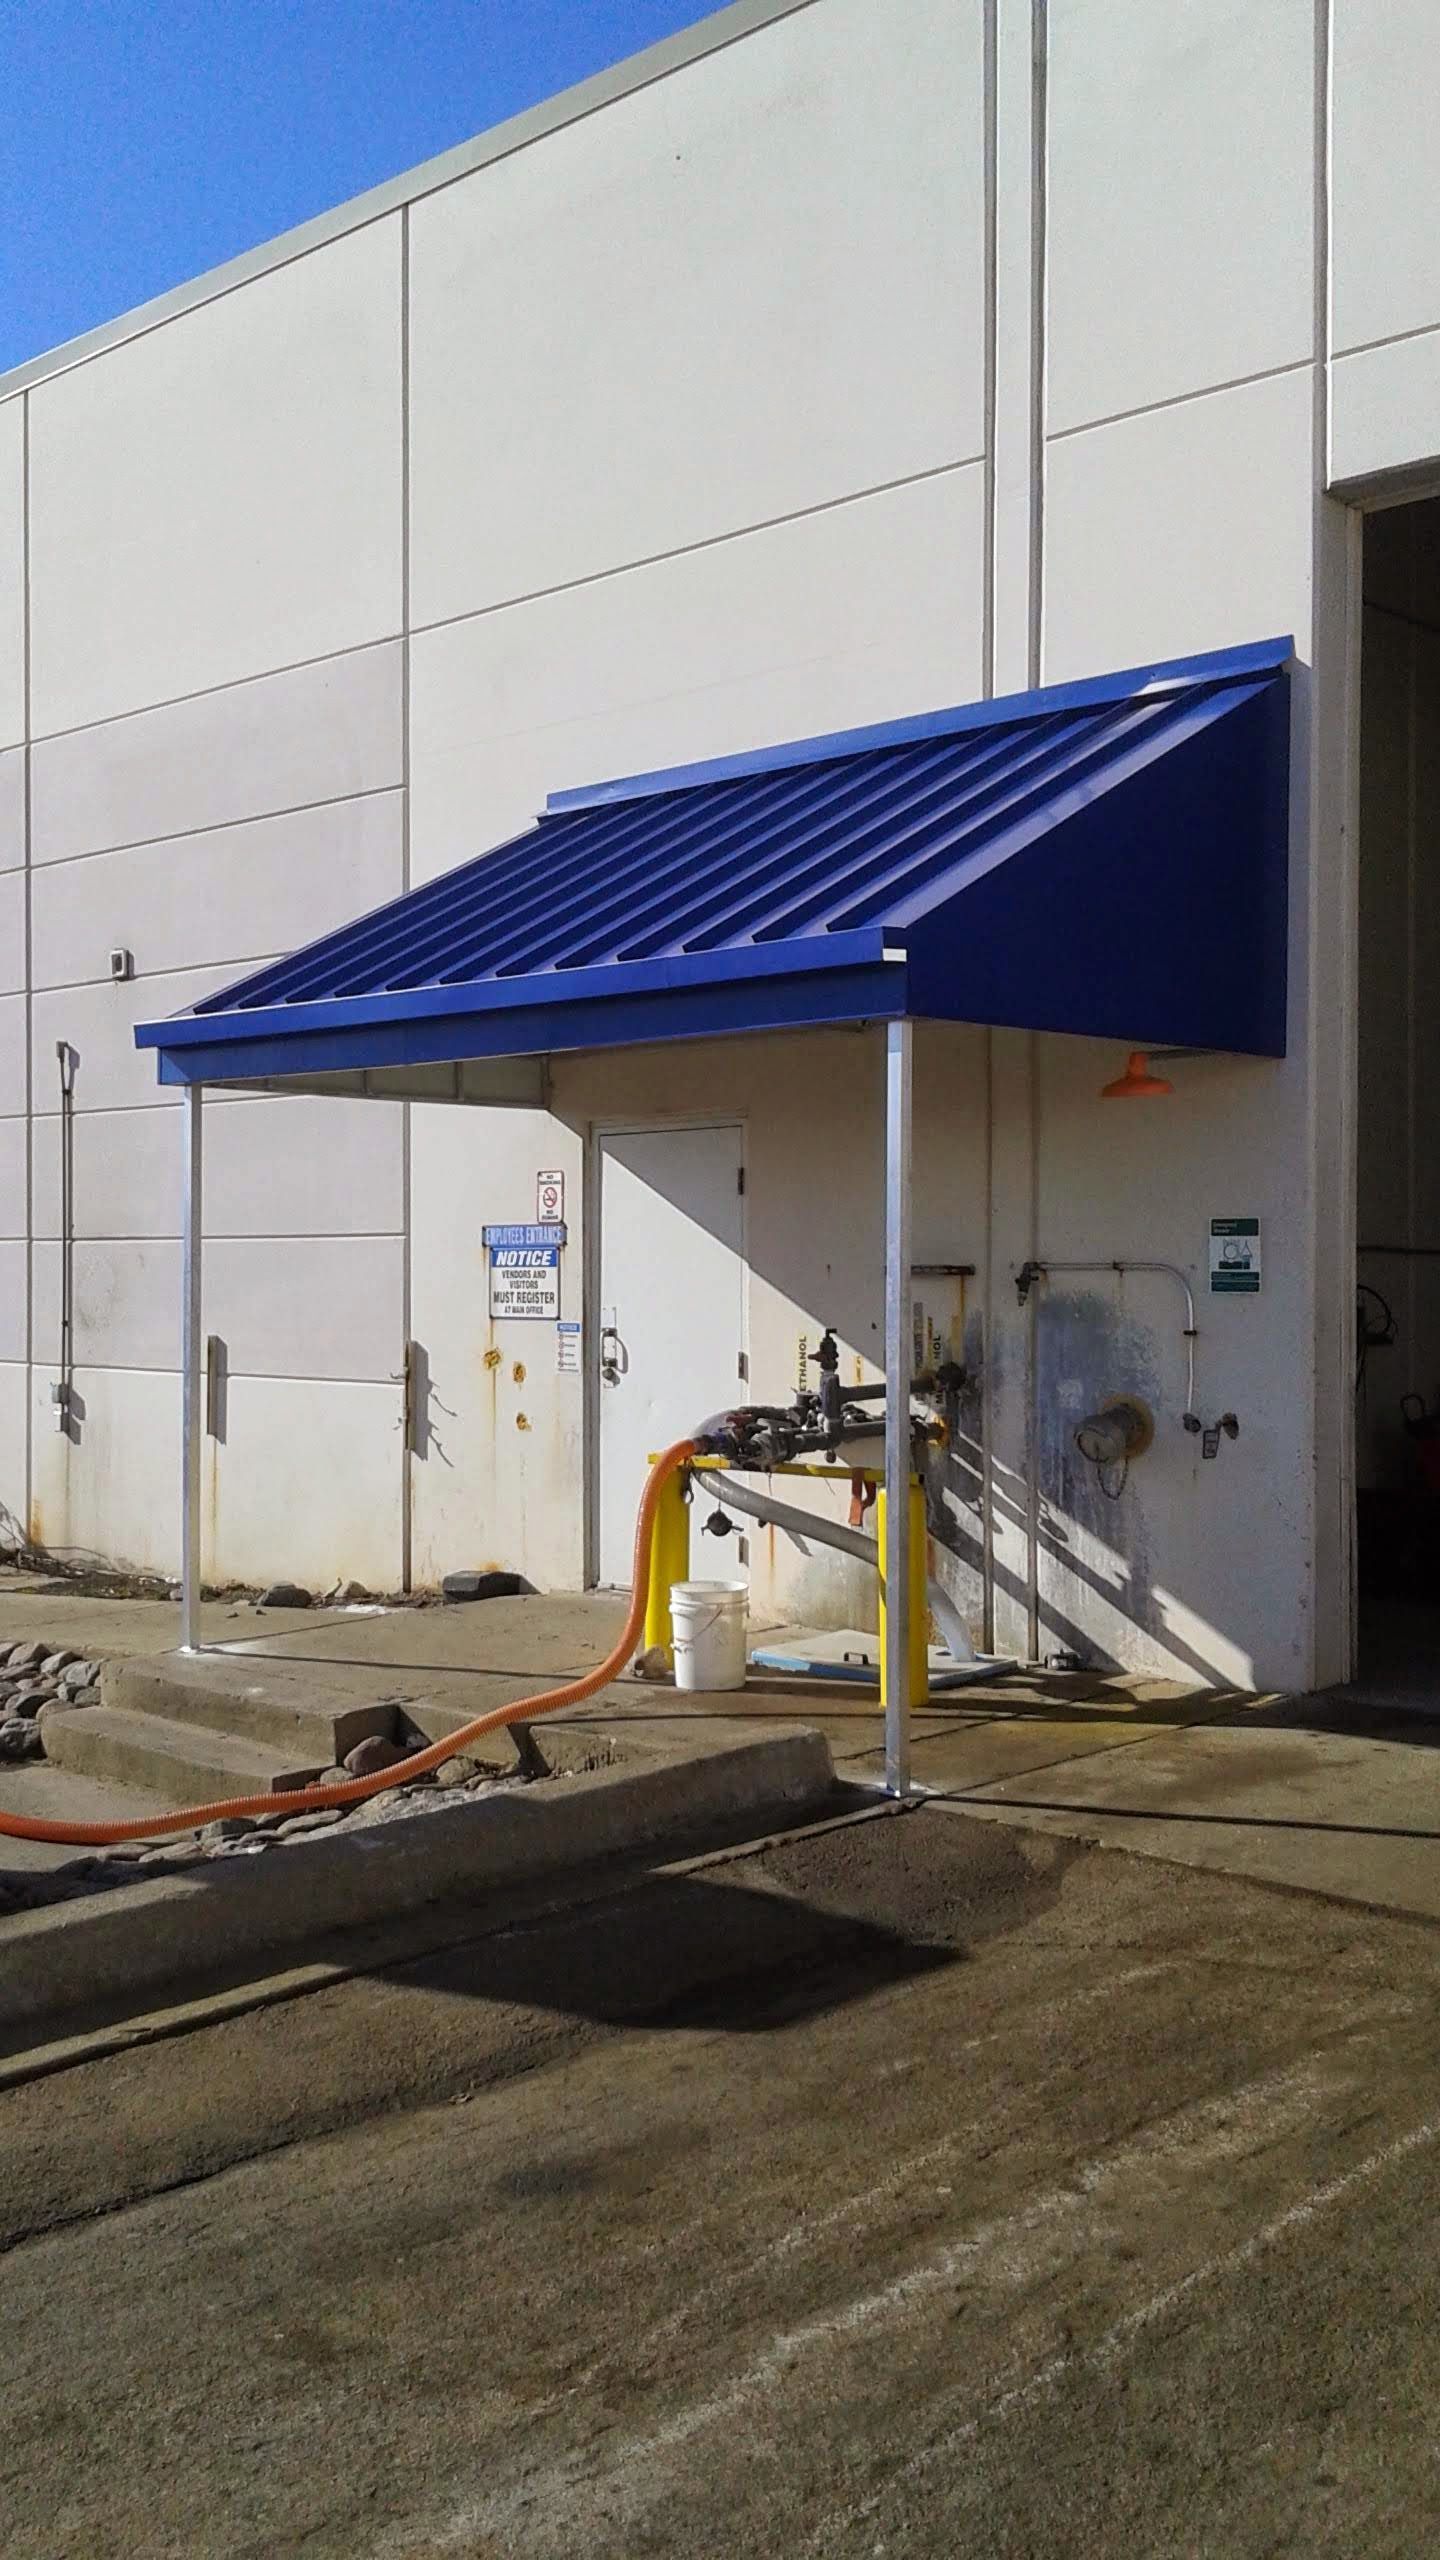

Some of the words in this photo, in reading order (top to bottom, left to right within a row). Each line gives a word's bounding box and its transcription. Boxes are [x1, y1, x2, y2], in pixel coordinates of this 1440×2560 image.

[486, 1226, 524, 1246] EMPLOYEES
[496, 1250, 552, 1266] NOTICE
[502, 1269, 532, 1279] VENDORS
[533, 1269, 547, 1279] AND
[509, 1280, 539, 1289] VISITORS
[493, 1291, 515, 1304] MUST
[516, 1291, 555, 1304] REGISTER
[504, 1305, 512, 1314] AT
[511, 1305, 525, 1314] MAIN
[525, 1305, 544, 1315] OFFICE
[798, 1336, 807, 1392] ETHANOL
